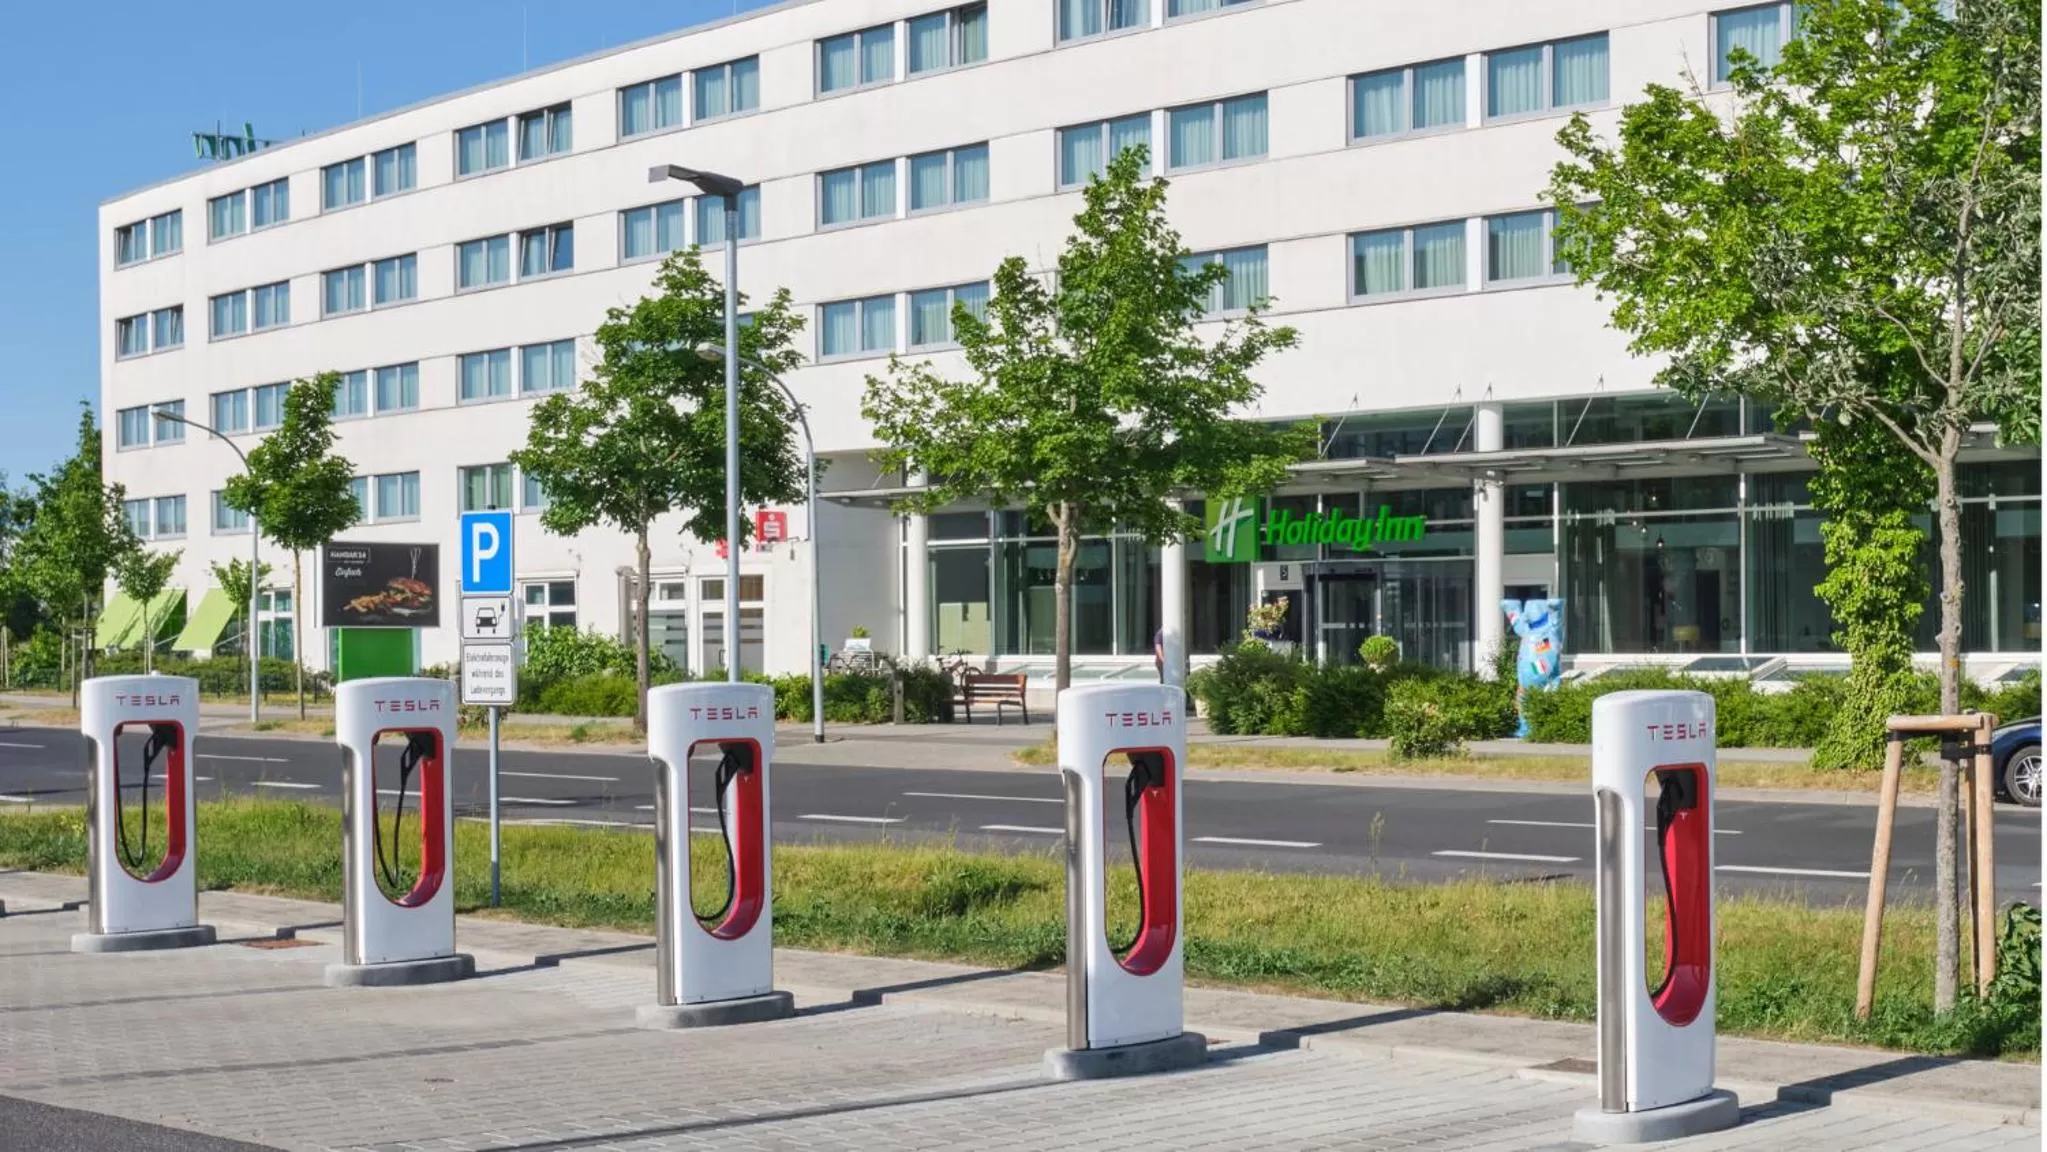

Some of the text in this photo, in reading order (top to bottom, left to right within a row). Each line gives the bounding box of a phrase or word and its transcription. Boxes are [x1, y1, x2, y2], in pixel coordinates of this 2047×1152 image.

[1267, 504, 1426, 552] Holiday Inn
[472, 522, 499, 583] P
[115, 695, 180, 706] TESLA
[374, 699, 440, 712] TESLA
[689, 707, 758, 720] TESLA
[1105, 712, 1171, 727] TESLA
[1647, 722, 1706, 740] TESLA
